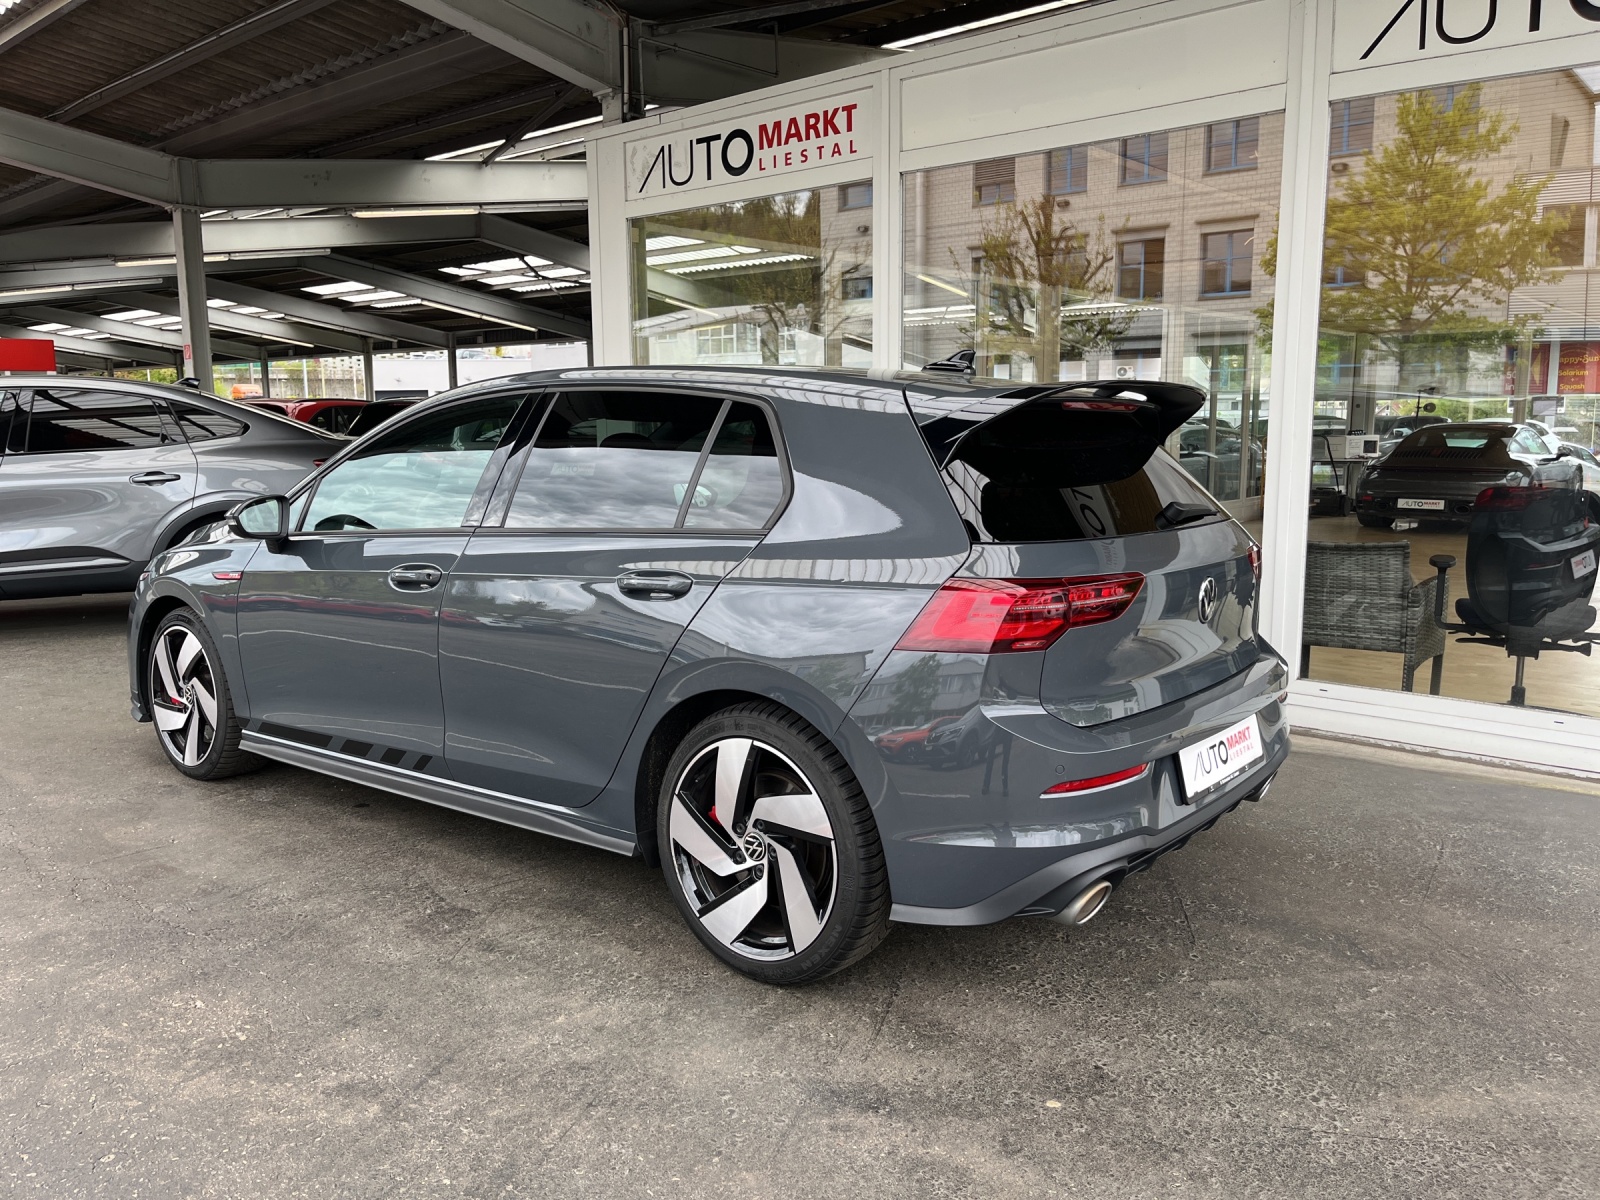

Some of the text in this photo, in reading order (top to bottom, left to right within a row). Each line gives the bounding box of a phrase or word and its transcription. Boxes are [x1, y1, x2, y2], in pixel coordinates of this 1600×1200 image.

[638, 103, 858, 193] AUTO MARKT
[758, 139, 858, 172] LIESTAL
[1559, 383, 1585, 391] Squash
[1194, 740, 1228, 781] AUTO
[1226, 726, 1251, 750] MARKT
[1229, 743, 1253, 761] LIESTAL
